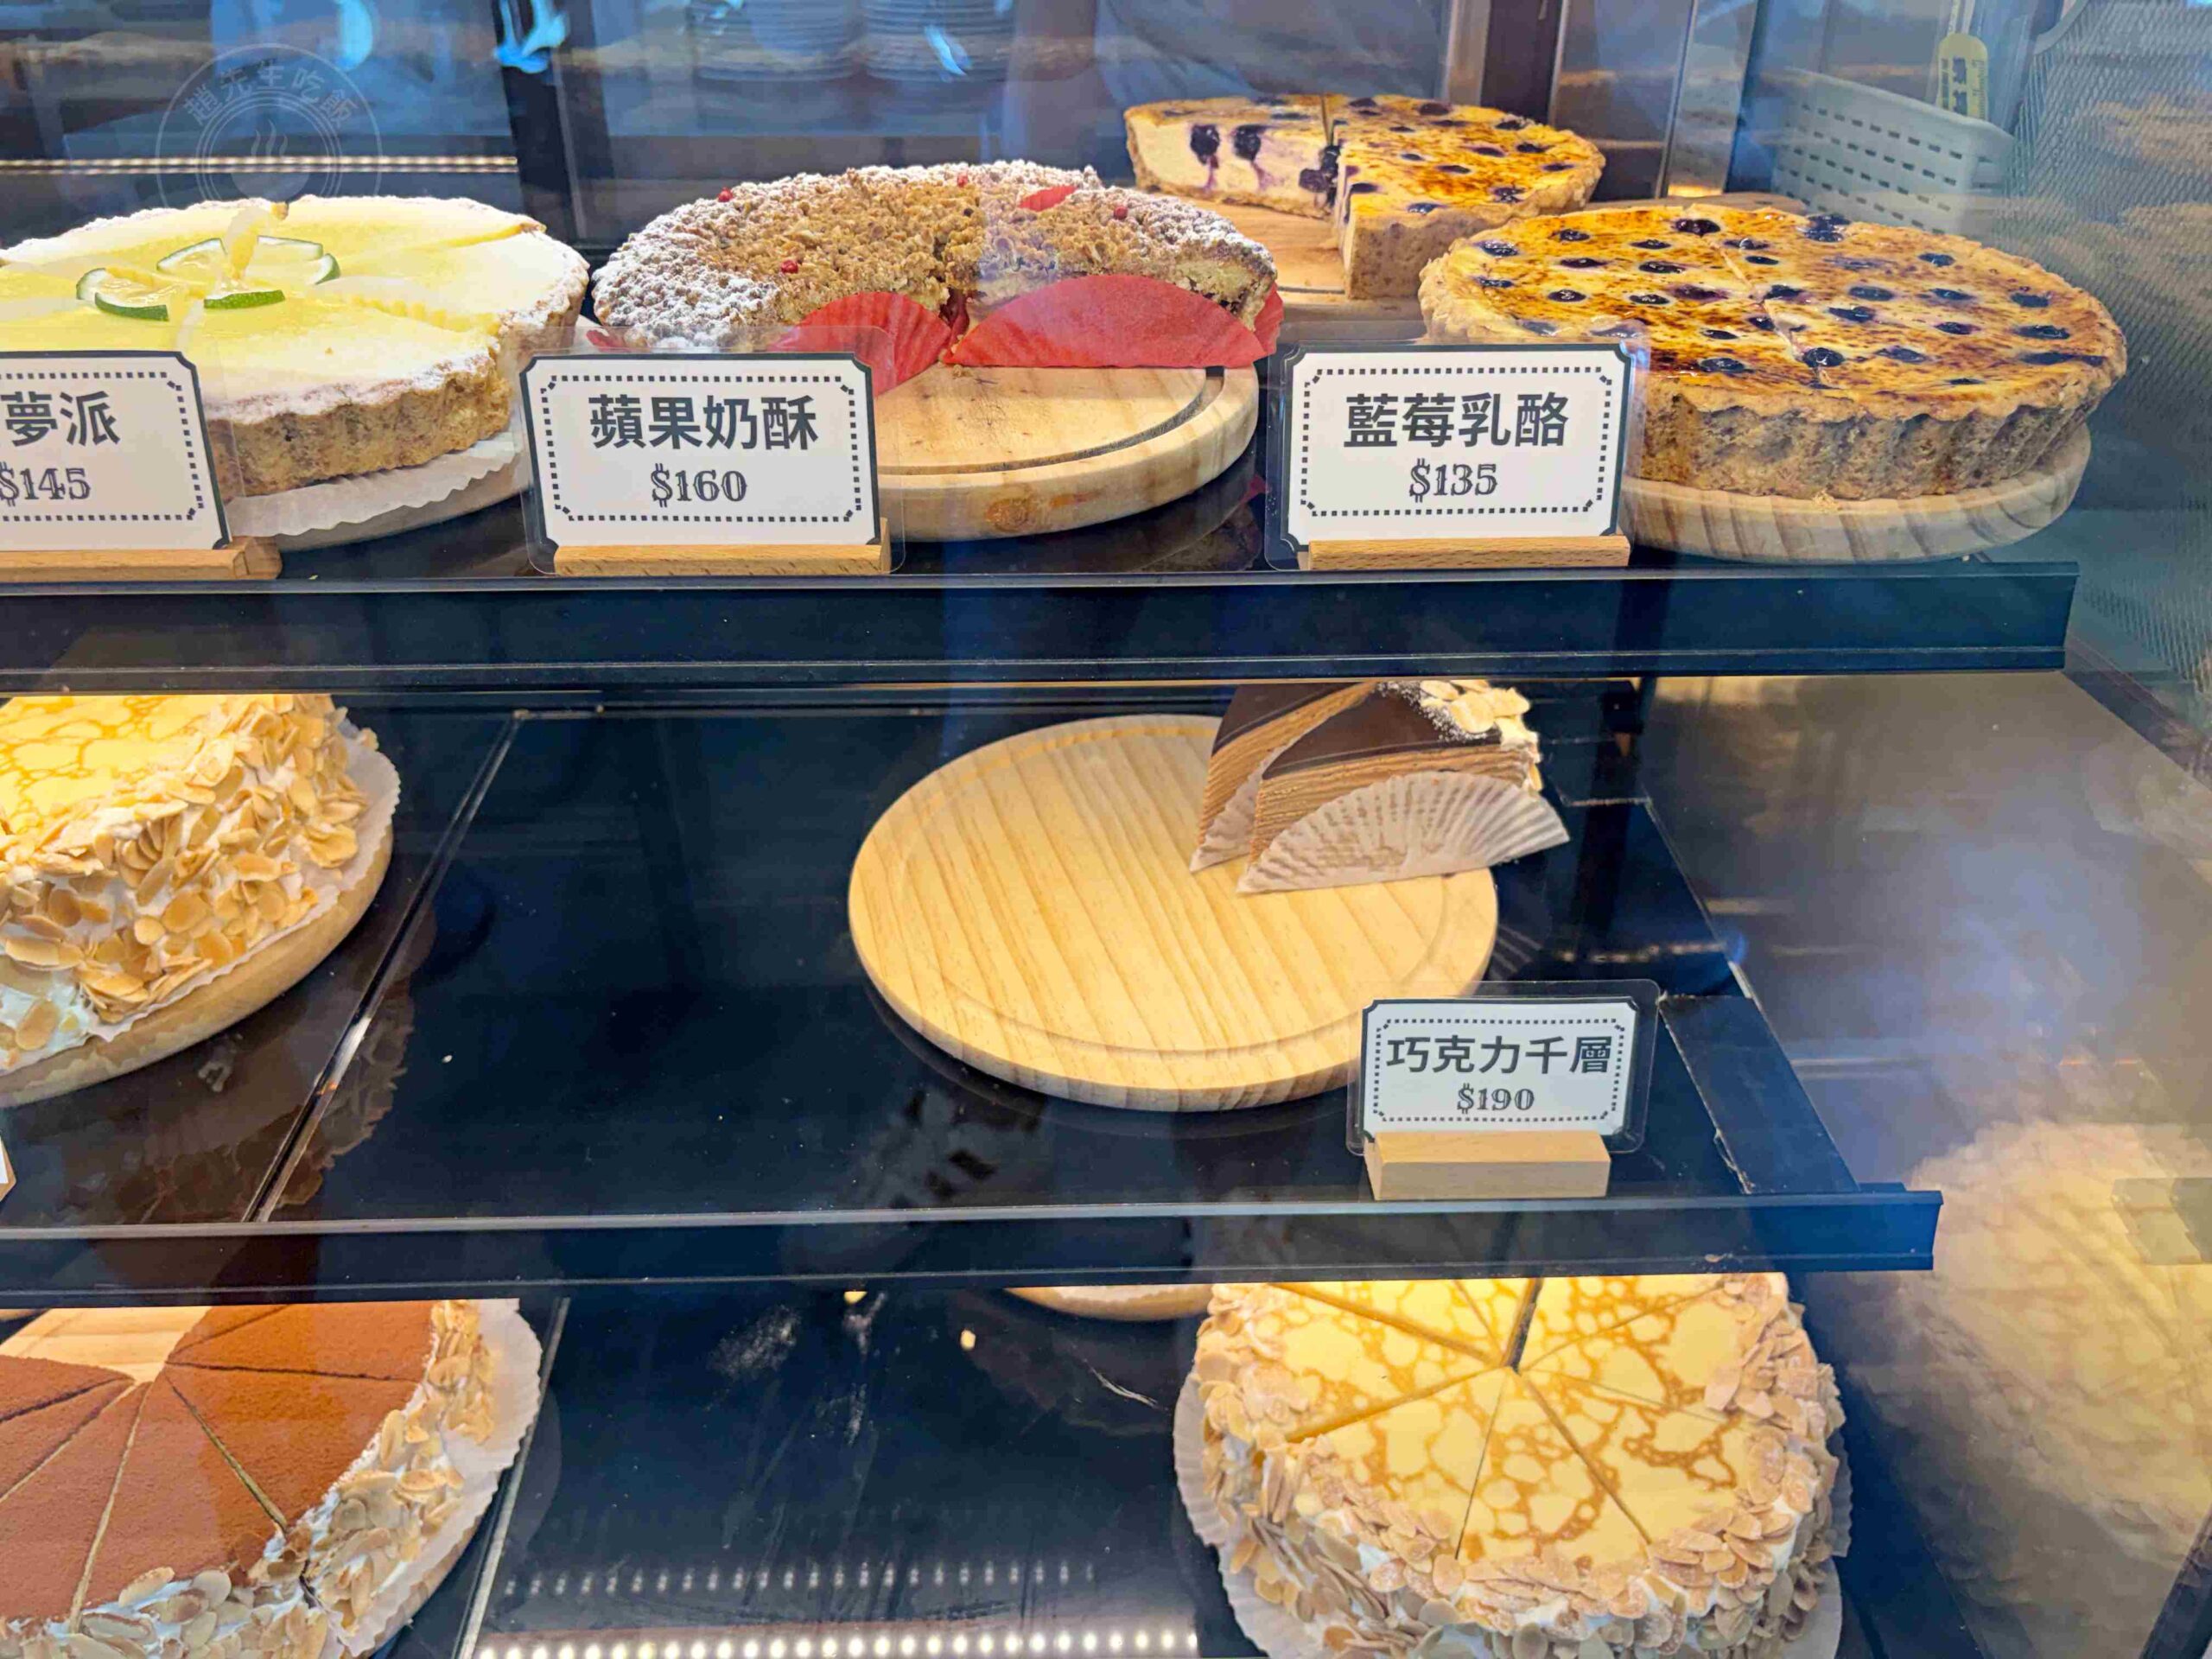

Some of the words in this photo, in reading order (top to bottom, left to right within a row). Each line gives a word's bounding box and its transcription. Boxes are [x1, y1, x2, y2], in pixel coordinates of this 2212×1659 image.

[0, 391, 120, 447] 夢派
[588, 394, 819, 450] 蘋果奶酥
[1344, 391, 1569, 448] 藍莓乳酪
[0, 461, 91, 507] $145
[651, 463, 747, 507] $160
[1409, 458, 1498, 503] $135
[1386, 1034, 1612, 1074] 巧克力千層
[1457, 1083, 1535, 1115] $190
